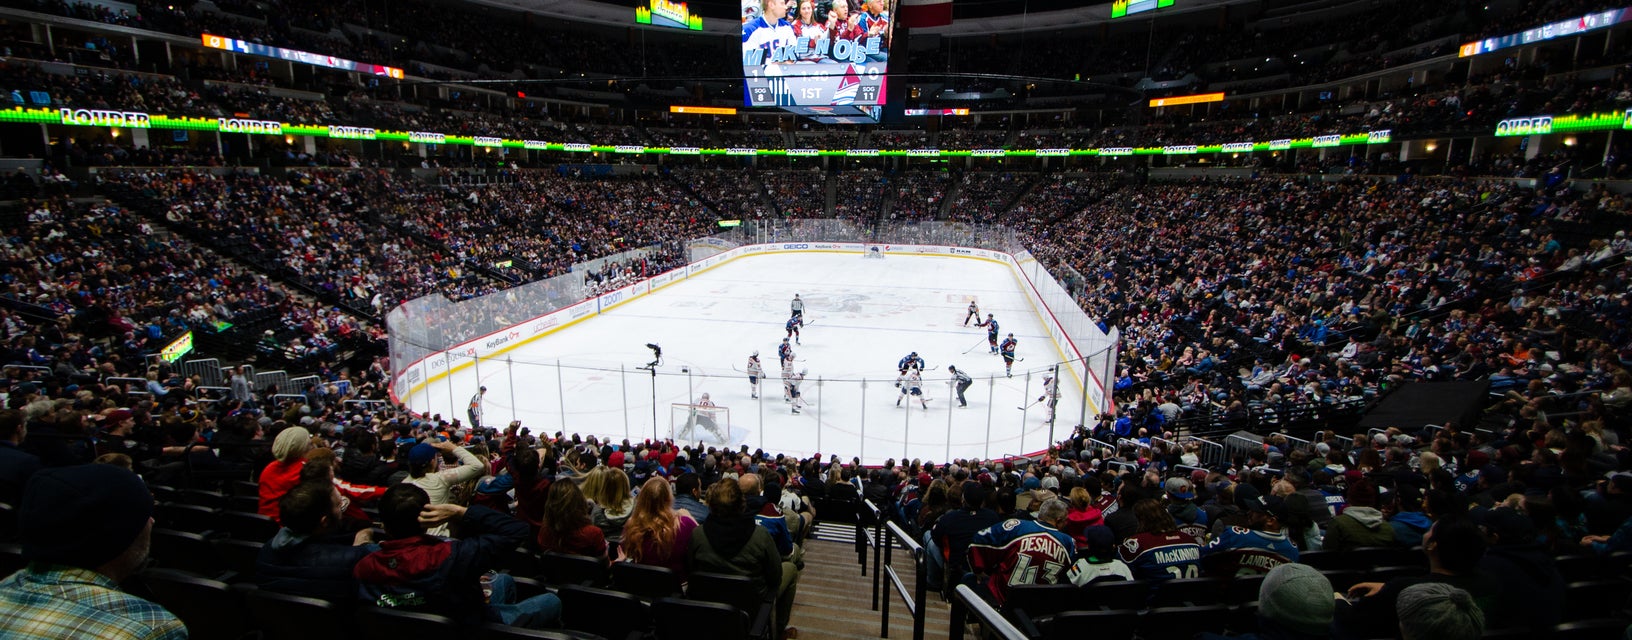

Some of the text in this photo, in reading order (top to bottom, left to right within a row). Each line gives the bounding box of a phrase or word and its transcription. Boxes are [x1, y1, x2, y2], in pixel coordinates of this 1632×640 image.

[815, 36, 881, 63] NOISE
[757, 94, 764, 102] 8
[801, 87, 822, 99] 1ST
[863, 92, 874, 100] 11
[60, 108, 151, 128] LOUDER
[218, 118, 282, 135] LOUDER
[328, 125, 376, 140] LOUDER
[1495, 117, 1552, 136] OUDER
[604, 291, 623, 306] zoom
[486, 336, 509, 349] KeyBank
[1020, 537, 1066, 563] DESALVO
[1008, 552, 1064, 586] 43
